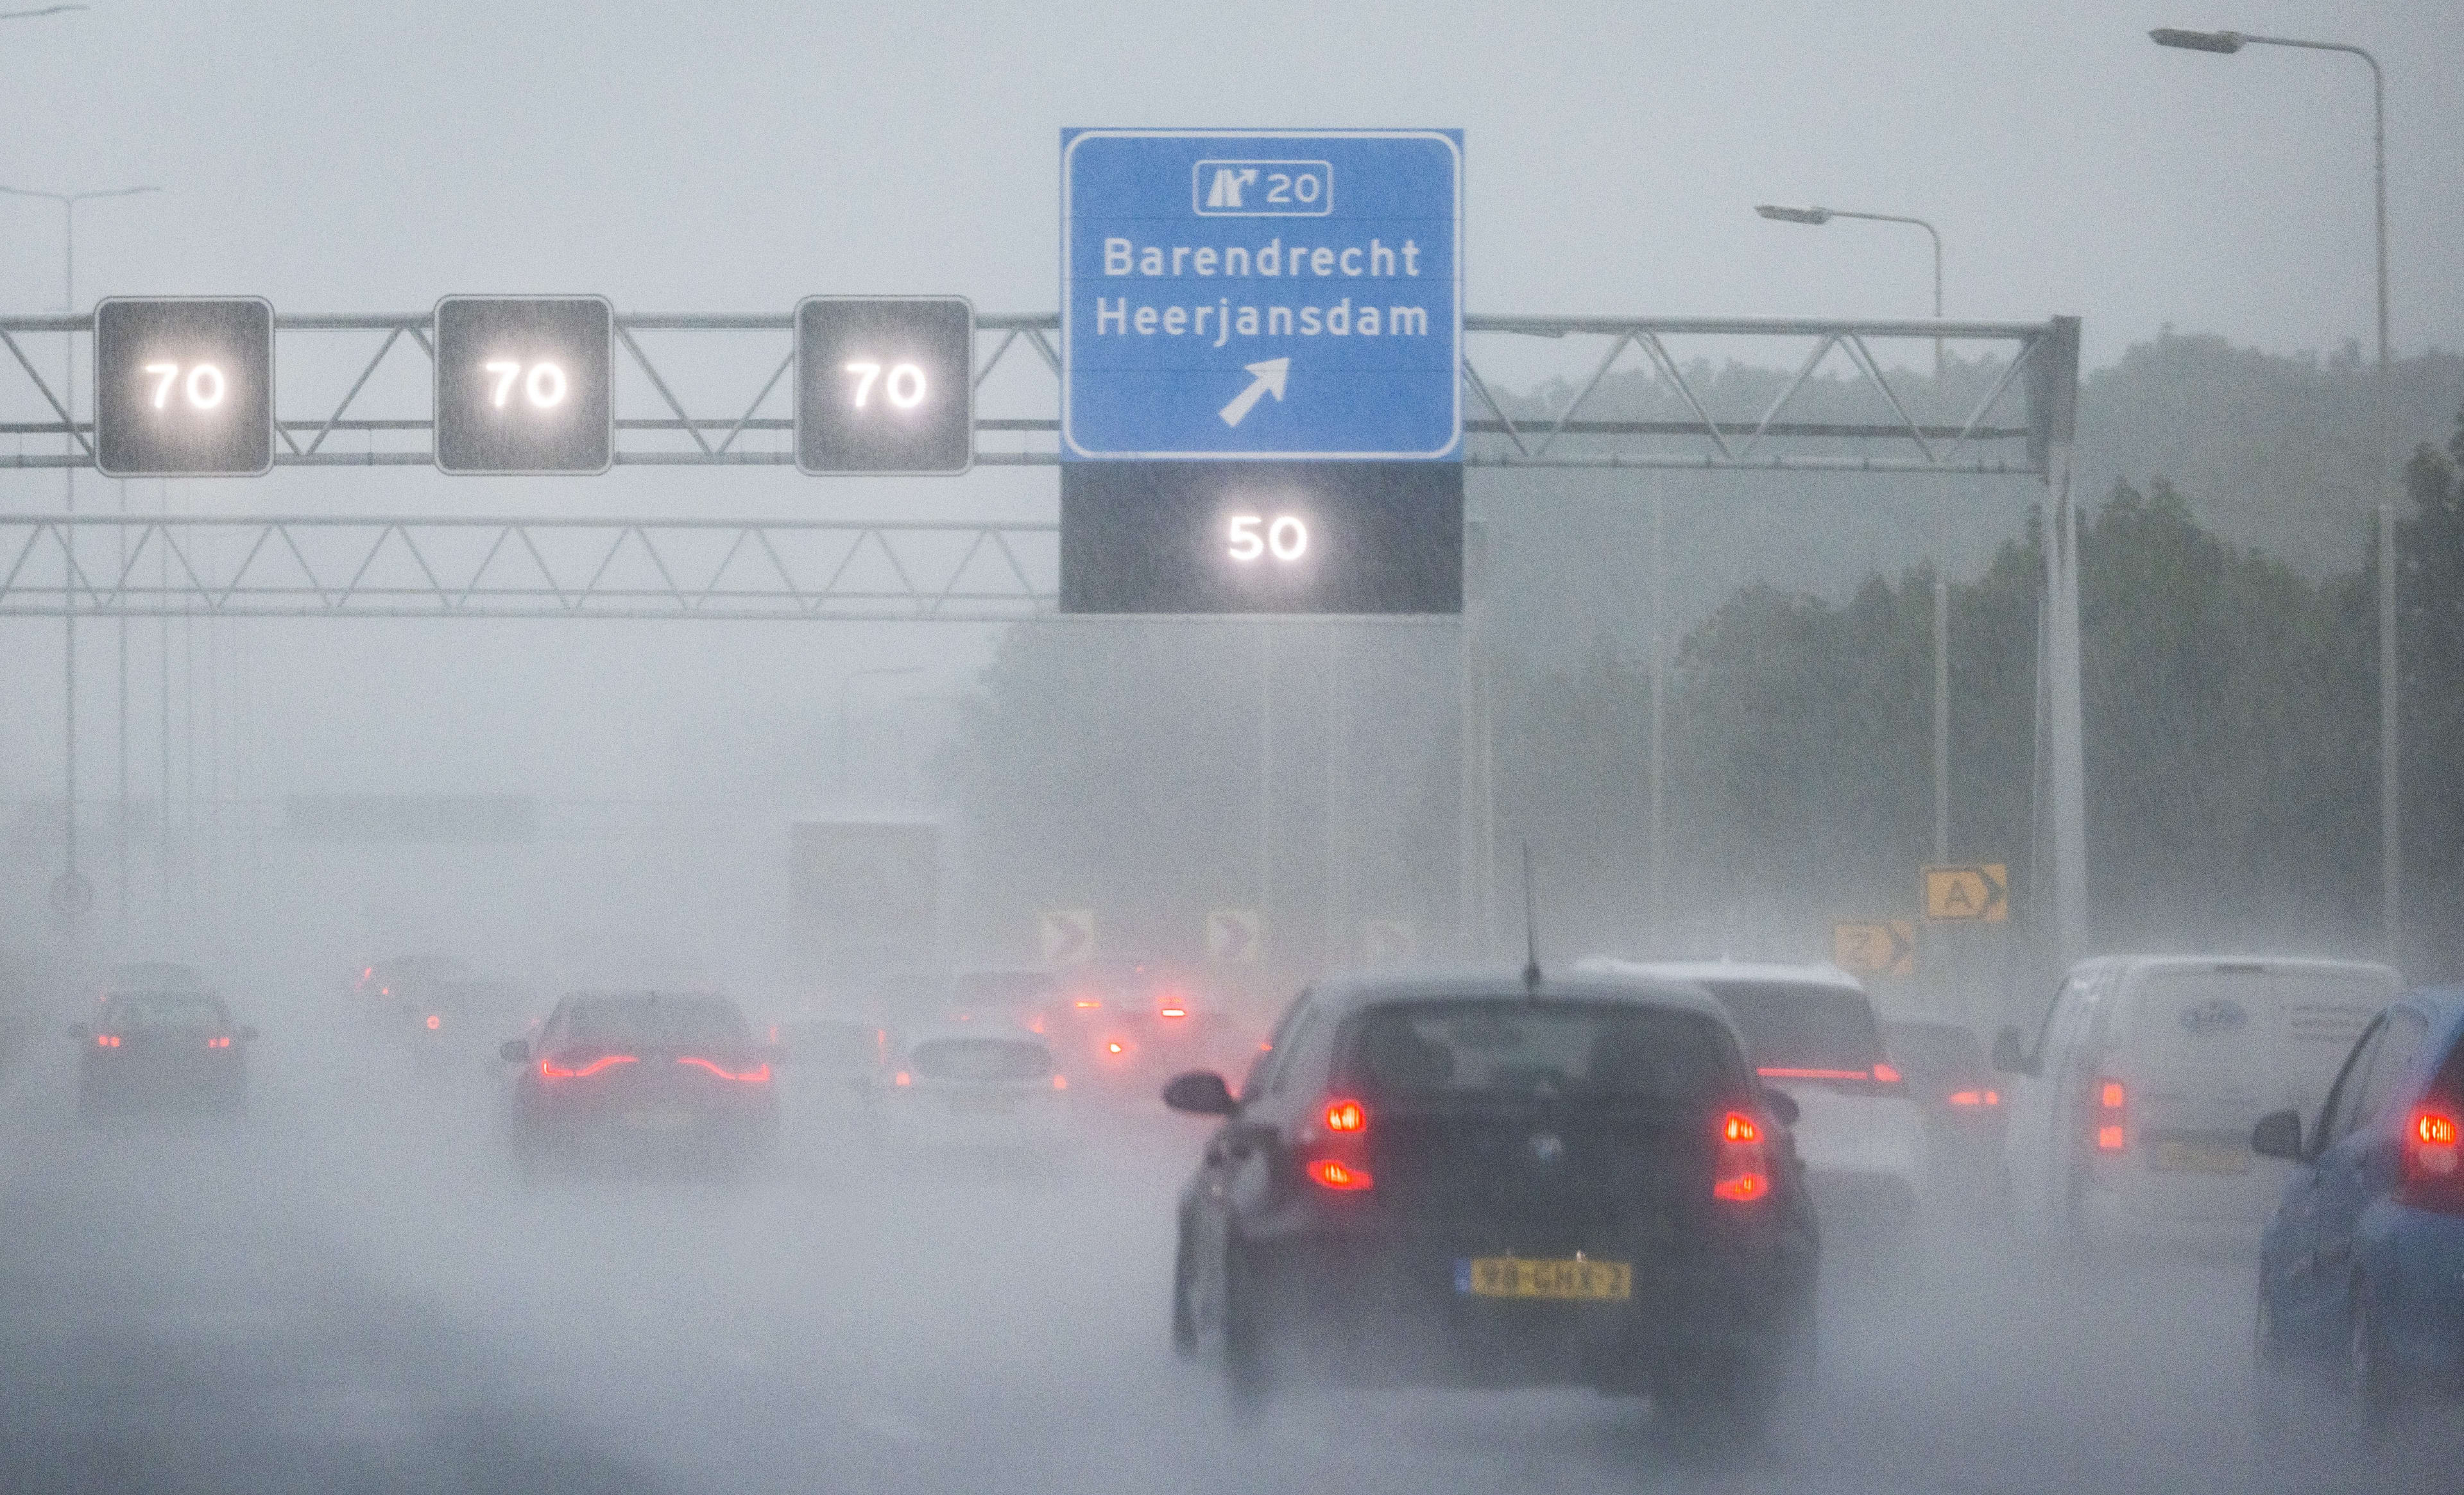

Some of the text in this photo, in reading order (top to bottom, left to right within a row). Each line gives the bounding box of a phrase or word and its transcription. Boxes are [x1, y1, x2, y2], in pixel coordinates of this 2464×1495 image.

[1267, 173, 1320, 203] 20
[1103, 237, 1420, 276] Barendrecht
[1096, 298, 1428, 347] Heerjansdam
[146, 363, 225, 410] 70
[485, 361, 567, 409] 70
[846, 362, 927, 409] 70
[1229, 516, 1308, 561] 50
[1944, 878, 1973, 910] A
